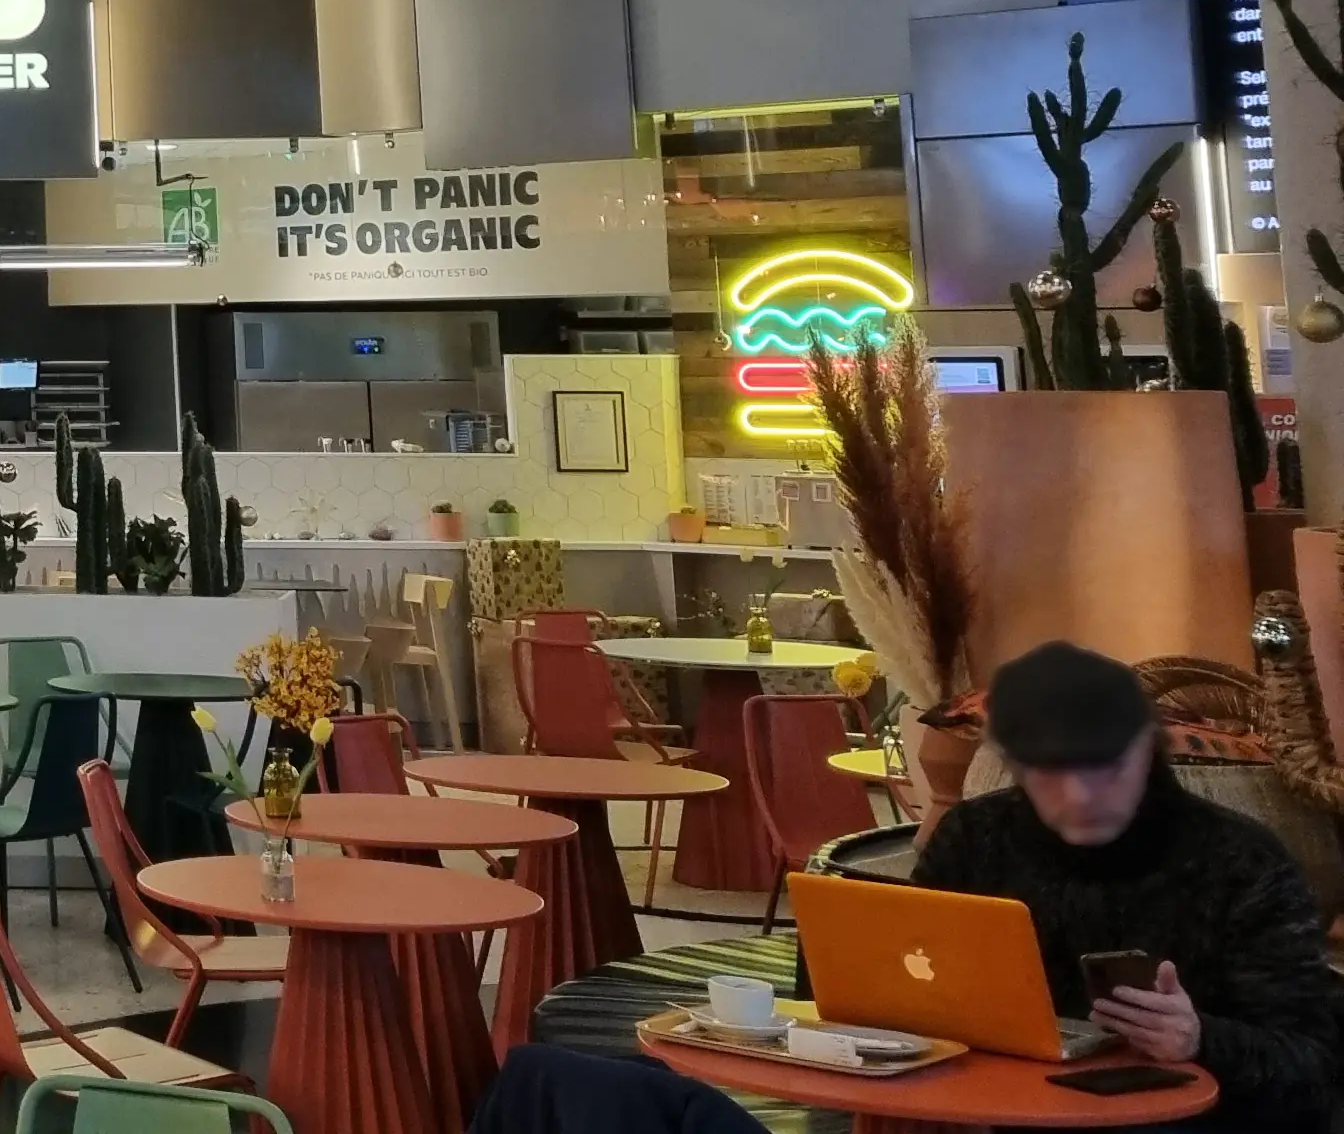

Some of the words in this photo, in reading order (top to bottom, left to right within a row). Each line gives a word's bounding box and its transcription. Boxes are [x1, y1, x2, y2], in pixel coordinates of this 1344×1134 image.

[274, 179, 397, 218] DON'T
[414, 171, 540, 210] PANIC
[277, 223, 349, 258] IT'S
[356, 215, 541, 255] ORGANIC
[334, 271, 349, 281] DE
[351, 270, 398, 280] PANIQU
[418, 268, 445, 278] TOUT
[447, 268, 466, 277] EST
[469, 267, 488, 277] BIO
